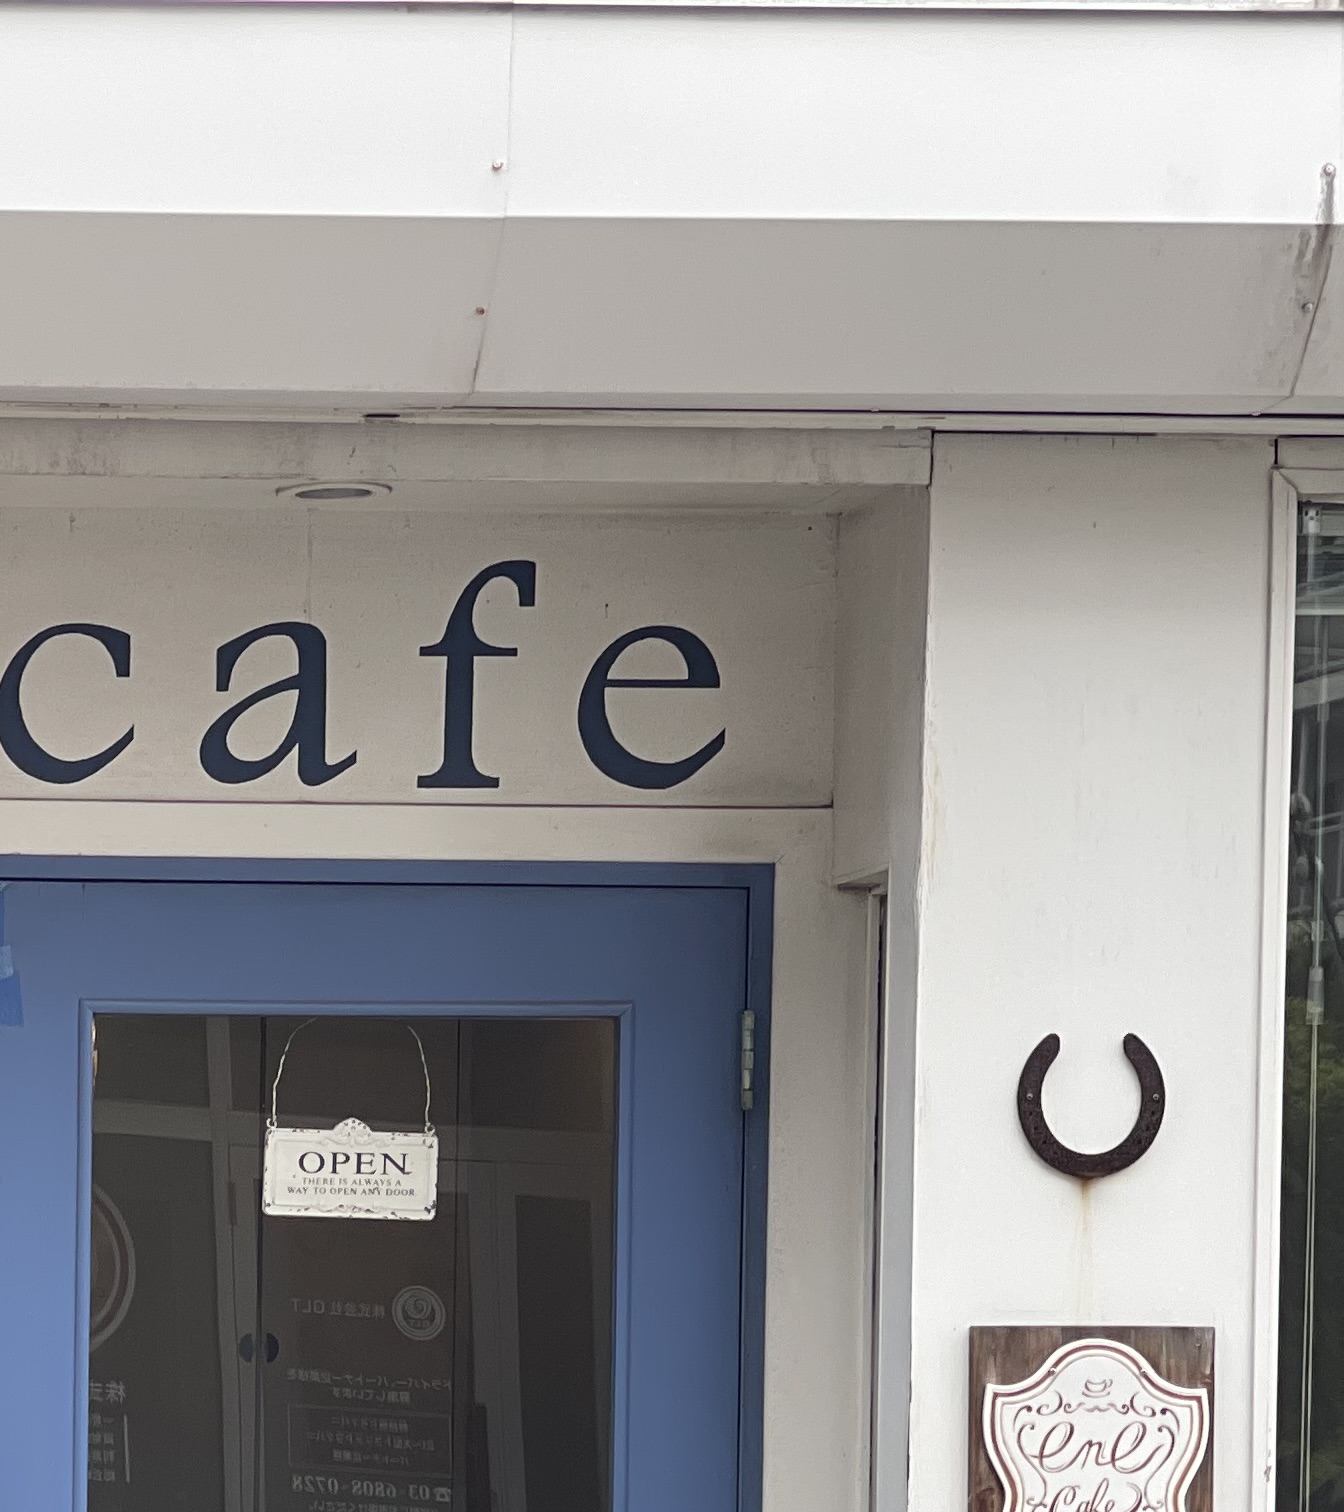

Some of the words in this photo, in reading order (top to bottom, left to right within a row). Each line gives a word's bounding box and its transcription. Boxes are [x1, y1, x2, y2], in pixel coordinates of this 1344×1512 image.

[298, 1151, 412, 1175] OPEN
[302, 1177, 335, 1186] THERE
[339, 1177, 348, 1186] IS
[351, 1178, 392, 1187] ALWAYS
[394, 1179, 402, 1187] A
[287, 1186, 308, 1195] WAY
[314, 1187, 326, 1195] TO
[329, 1187, 357, 1196] OPEN
[360, 1188, 382, 1196] ANY
[385, 1188, 415, 1197] DOOR
